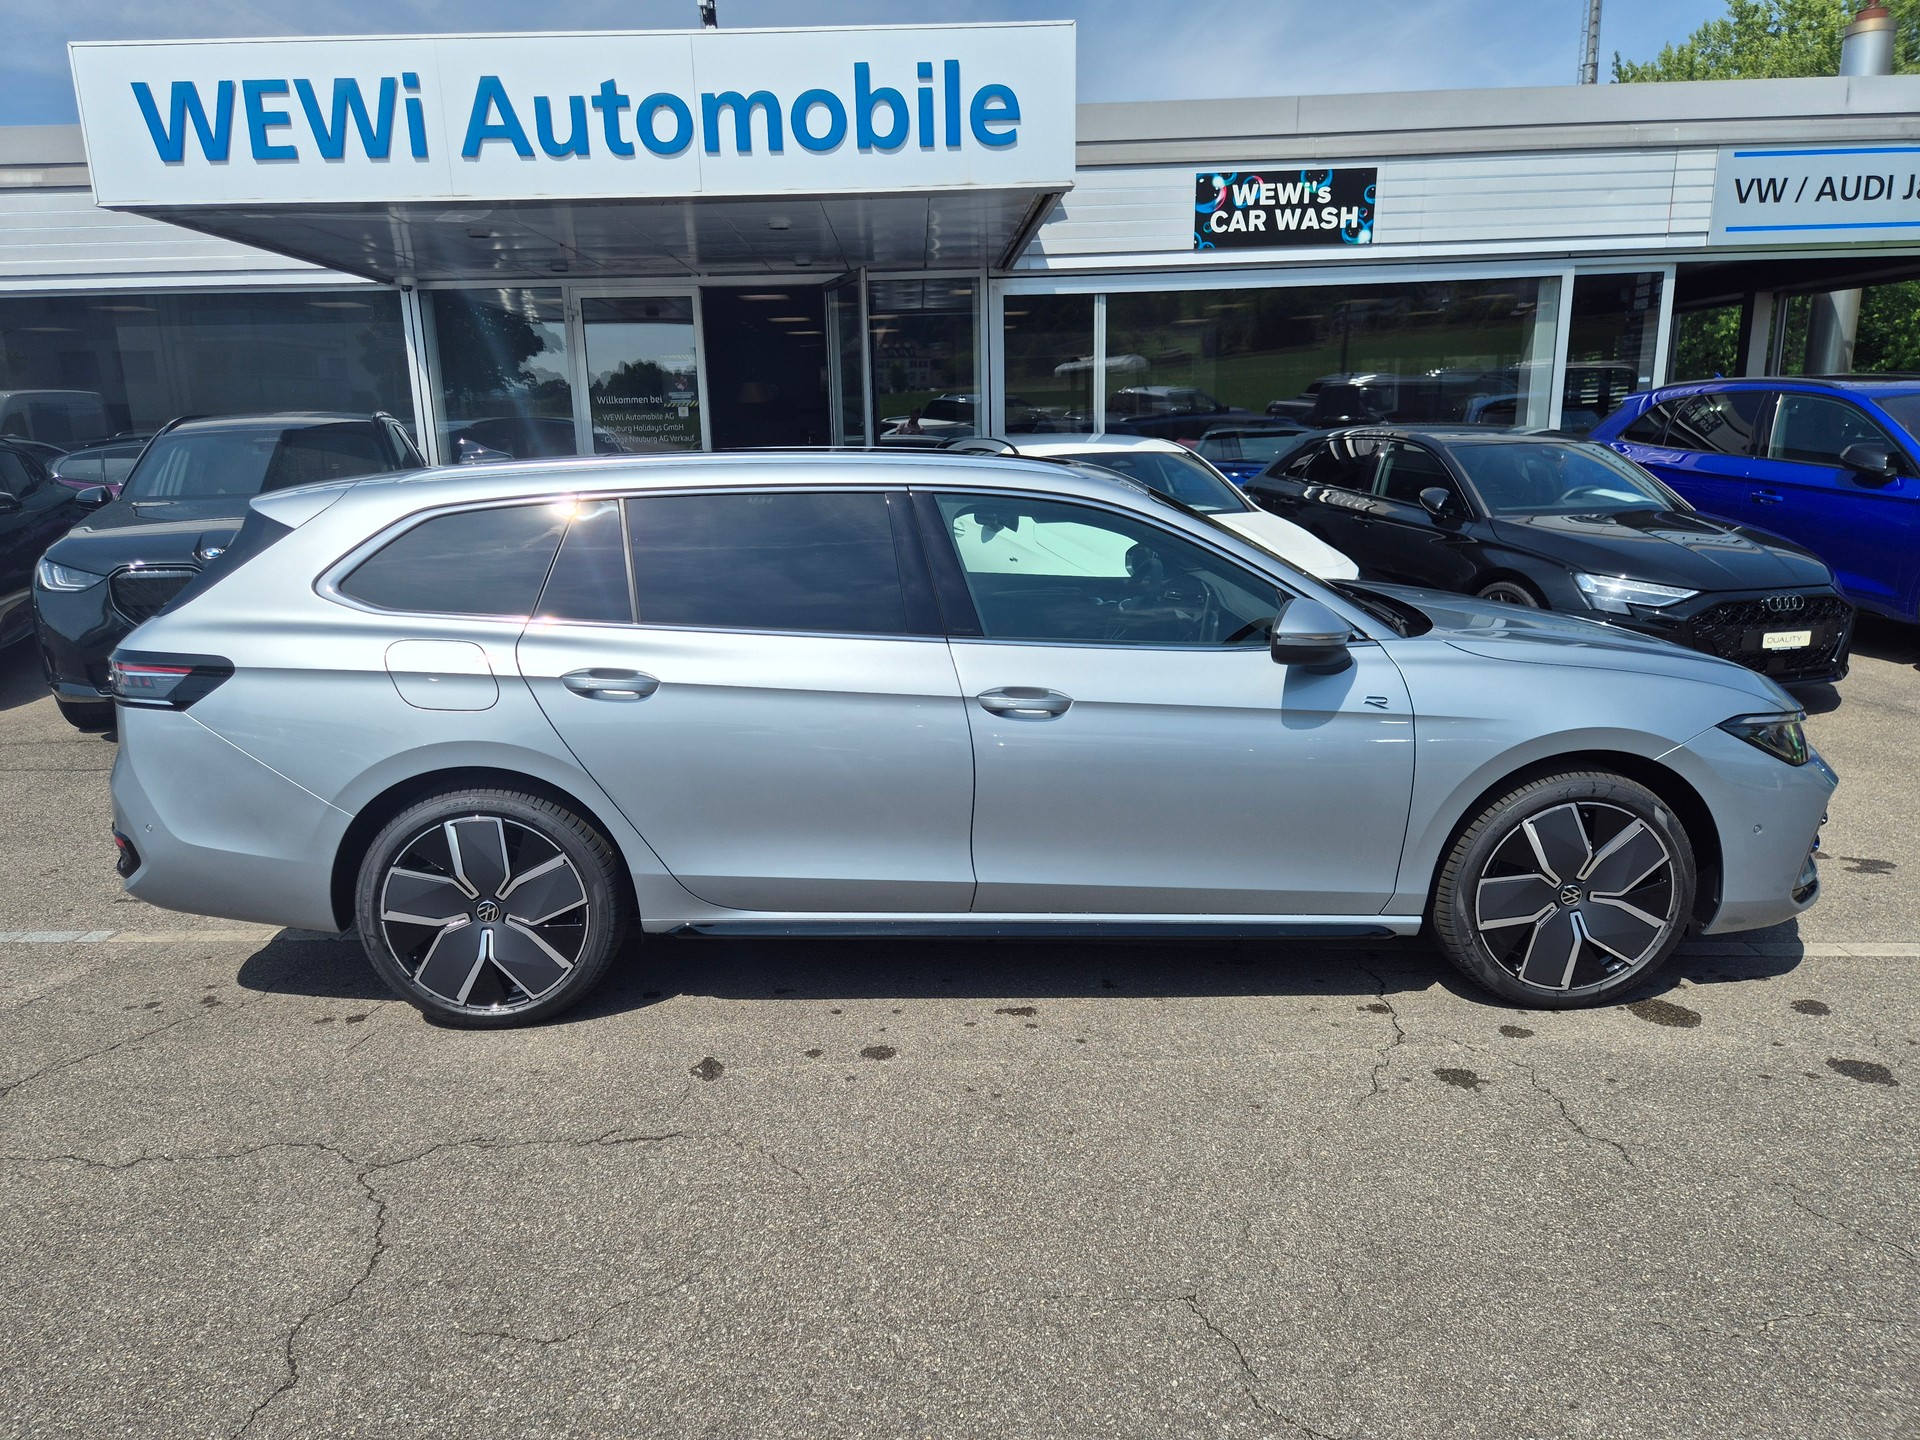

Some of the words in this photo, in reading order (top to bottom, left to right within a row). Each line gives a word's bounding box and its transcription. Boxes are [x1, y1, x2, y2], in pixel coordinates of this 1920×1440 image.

[130, 71, 429, 163] WEWi
[461, 59, 1021, 158] Automobile
[1232, 181, 1332, 207] WEWi's
[1734, 177, 1789, 204] VW
[1814, 174, 1895, 202] AUDI
[1902, 174, 1920, 200] J
[1210, 209, 1267, 233] CAR
[1275, 206, 1359, 231] WASH
[596, 395, 649, 405] Willkommen
[650, 394, 663, 404] bei
[602, 413, 624, 421] WEWi
[625, 412, 664, 421] Automobile
[664, 412, 675, 420] AG
[603, 425, 633, 434] Neuburg
[633, 424, 663, 434] Holidays
[663, 423, 685, 431] GmbH
[629, 435, 658, 444] Neuburg
[658, 434, 669, 442] AG
[1766, 635, 1802, 644] QUALITY
